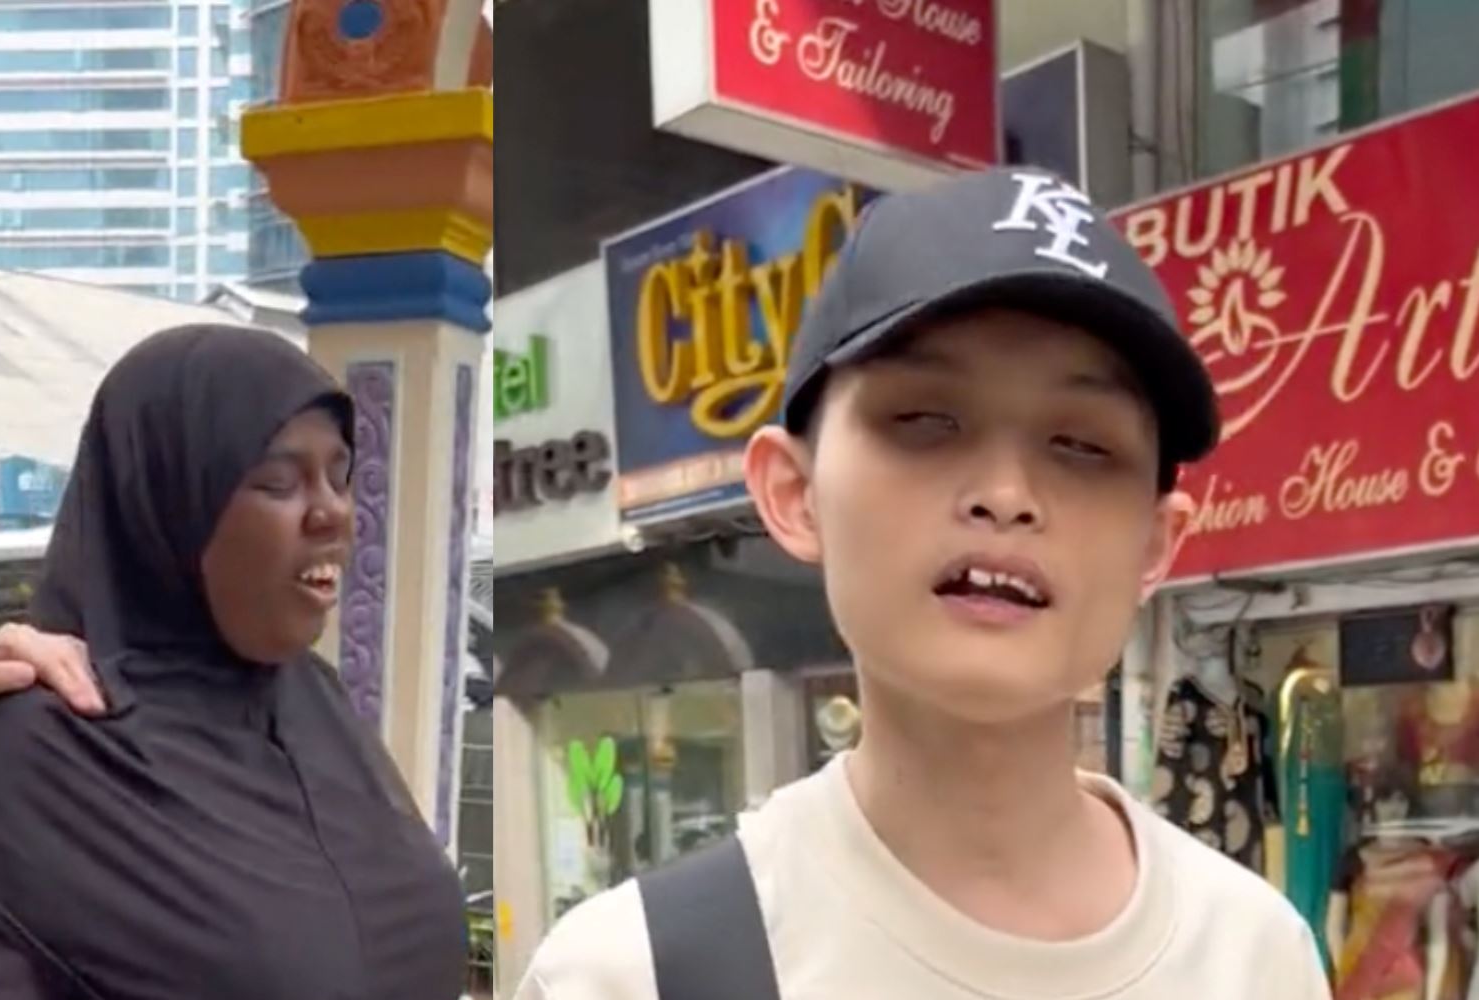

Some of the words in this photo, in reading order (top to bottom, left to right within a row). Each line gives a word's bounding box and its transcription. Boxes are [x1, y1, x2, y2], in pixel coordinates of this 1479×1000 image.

[749, 0, 791, 65] &
[796, 16, 955, 144] Tailoring
[1126, 144, 1355, 267] BUTIK
[1278, 440, 1409, 520] House
[1419, 422, 1466, 496] &
